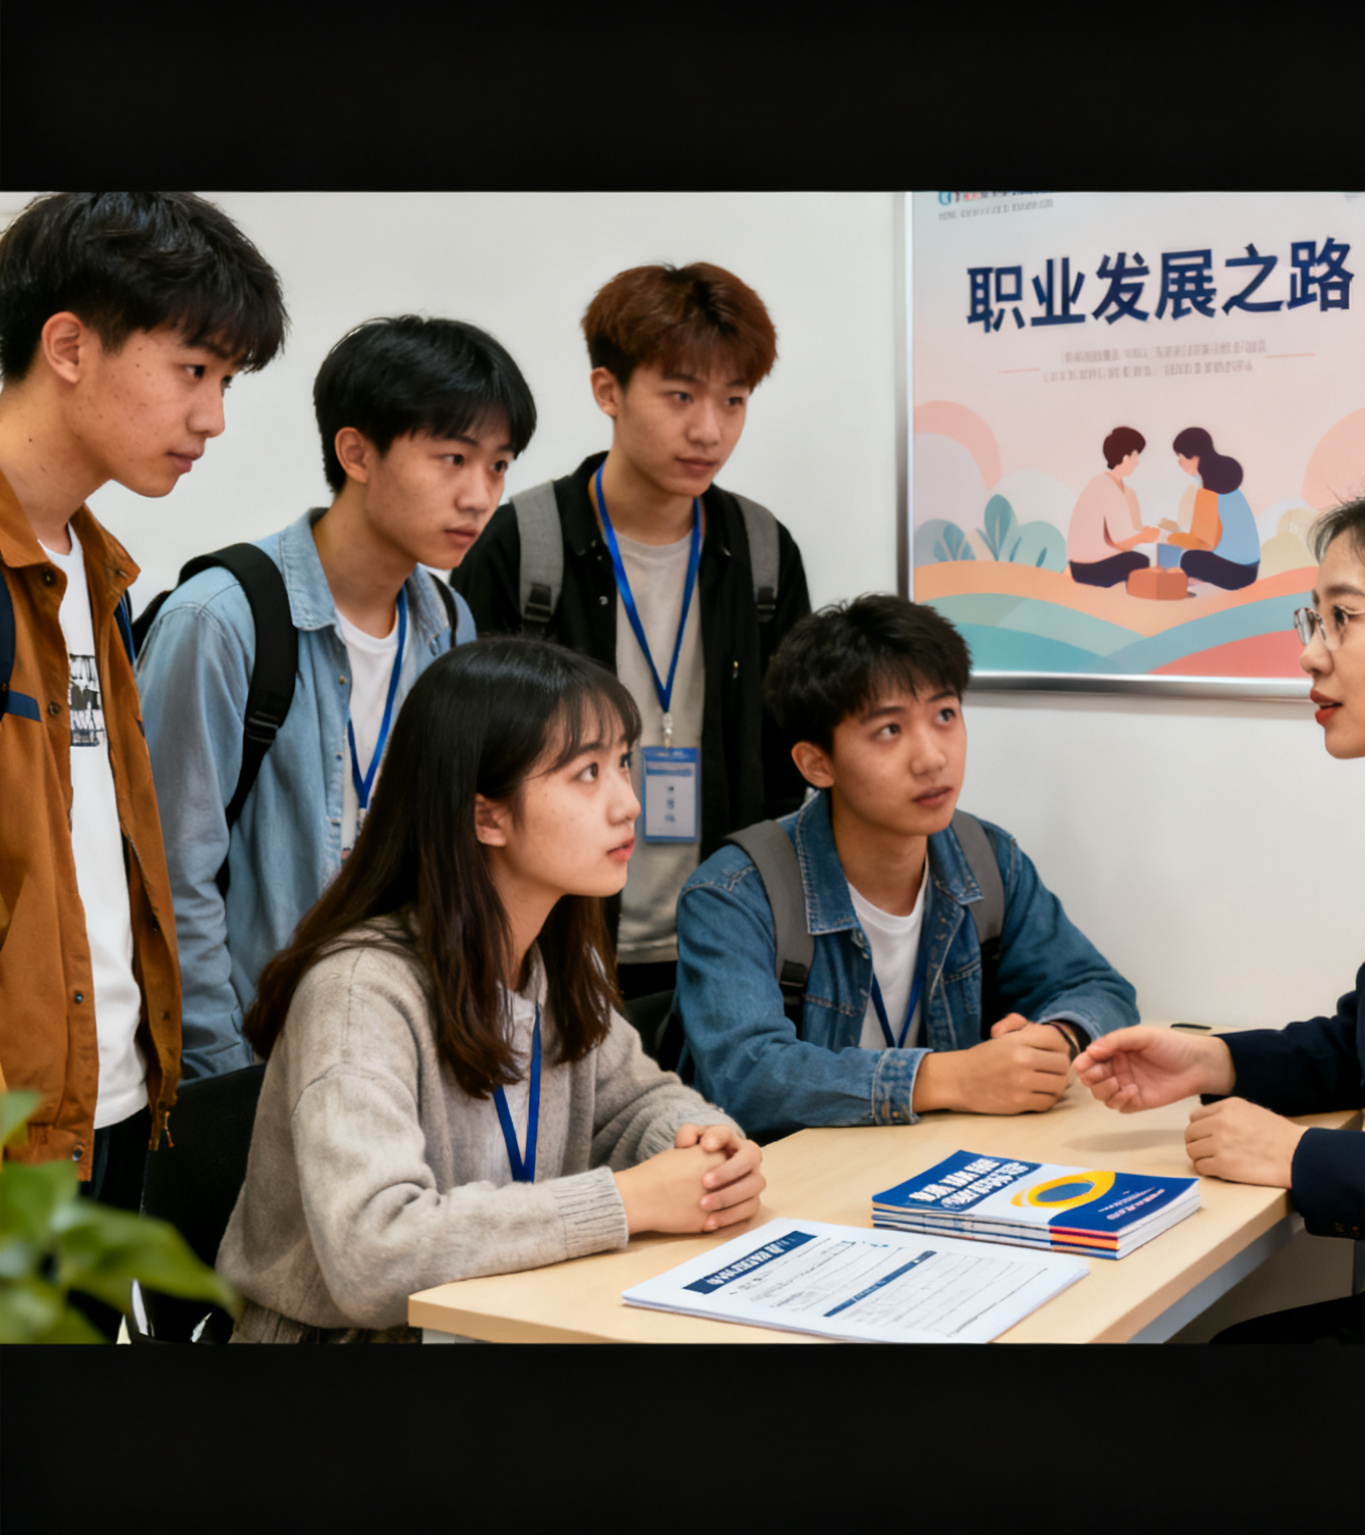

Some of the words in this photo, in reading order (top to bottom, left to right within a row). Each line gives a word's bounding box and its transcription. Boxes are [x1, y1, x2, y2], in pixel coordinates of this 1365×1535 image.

[965, 236, 1355, 334] 职业发展之路
